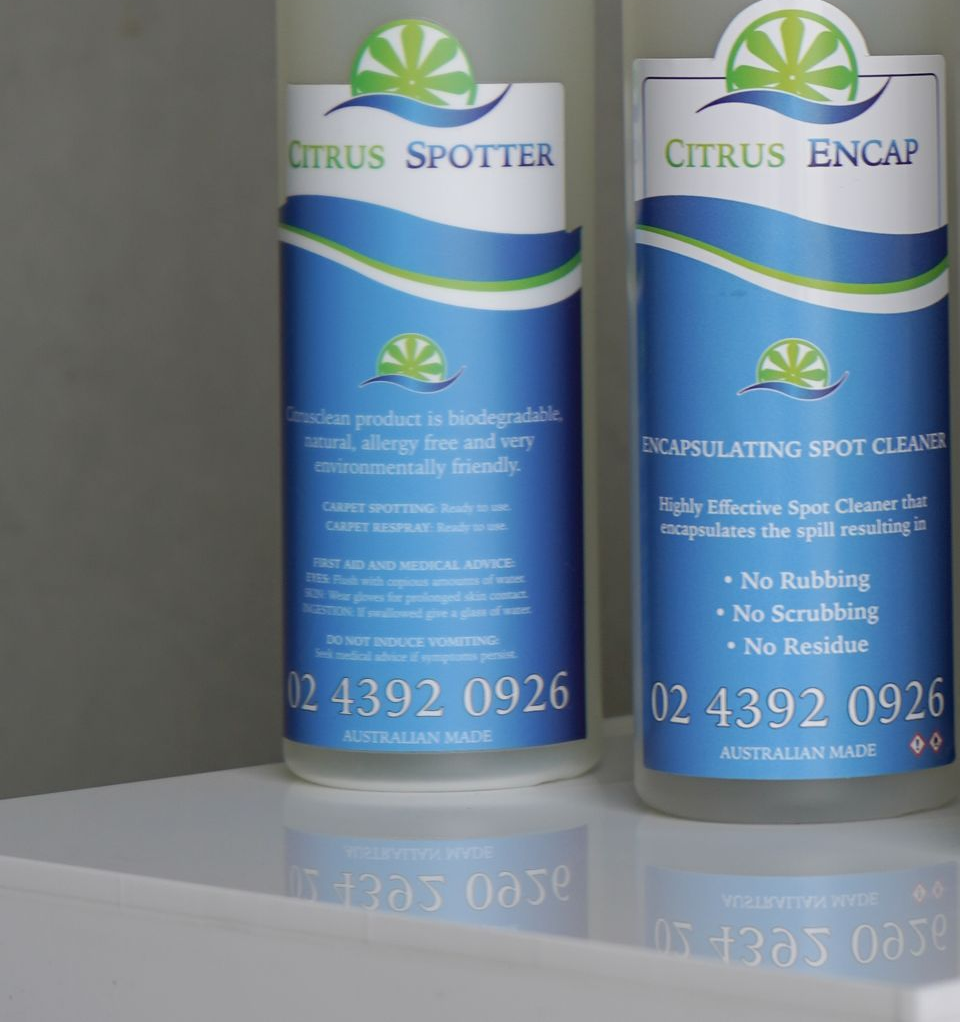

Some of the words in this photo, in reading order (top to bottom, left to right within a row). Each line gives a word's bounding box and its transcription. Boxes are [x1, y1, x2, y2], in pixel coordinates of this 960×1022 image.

[288, 140, 385, 169] CITRUS
[406, 141, 555, 169] SPOTTER
[664, 138, 786, 169] CITRUS
[806, 137, 919, 168] ENCAP
[355, 410, 421, 430] product
[428, 411, 443, 427] is
[448, 406, 563, 428] biodegradable,
[304, 434, 356, 453] natural,
[361, 434, 419, 455] allergy
[423, 434, 458, 451] free
[464, 433, 496, 450] and
[500, 435, 535, 451] very
[642, 436, 802, 458] ENCAPSULATING
[808, 439, 867, 458] SPOT
[871, 432, 947, 454] CLEANER
[314, 458, 447, 478] environmentally
[451, 457, 521, 476] friendly.
[659, 496, 702, 518] Highly
[707, 499, 783, 516] Effective
[787, 499, 830, 519] Spot
[834, 497, 899, 515] Cleaner
[901, 494, 928, 510] that
[660, 520, 756, 541] encapsulates
[760, 522, 791, 539] the
[796, 521, 836, 542] spill
[839, 518, 911, 537] resulting
[913, 516, 927, 531] in
[313, 557, 340, 569] FIRST
[343, 559, 365, 570] AID
[368, 560, 397, 571] AND
[399, 560, 460, 571] MEDICAL
[740, 571, 774, 590] No
[779, 569, 871, 593] Rubbing
[732, 604, 765, 623] No
[771, 602, 879, 625] Scrubbing
[743, 637, 777, 656] No
[783, 635, 869, 656] Residue
[287, 670, 319, 712] 02
[330, 676, 445, 718] 4392
[463, 670, 570, 717] 0926
[651, 681, 691, 725] 02
[705, 686, 830, 729] 4392
[847, 676, 945, 727] 0926
[343, 729, 442, 745] AUSTRALIAN
[445, 729, 493, 744] MADE
[719, 745, 826, 761] AUSTRALIAN
[829, 743, 877, 759] MADE
